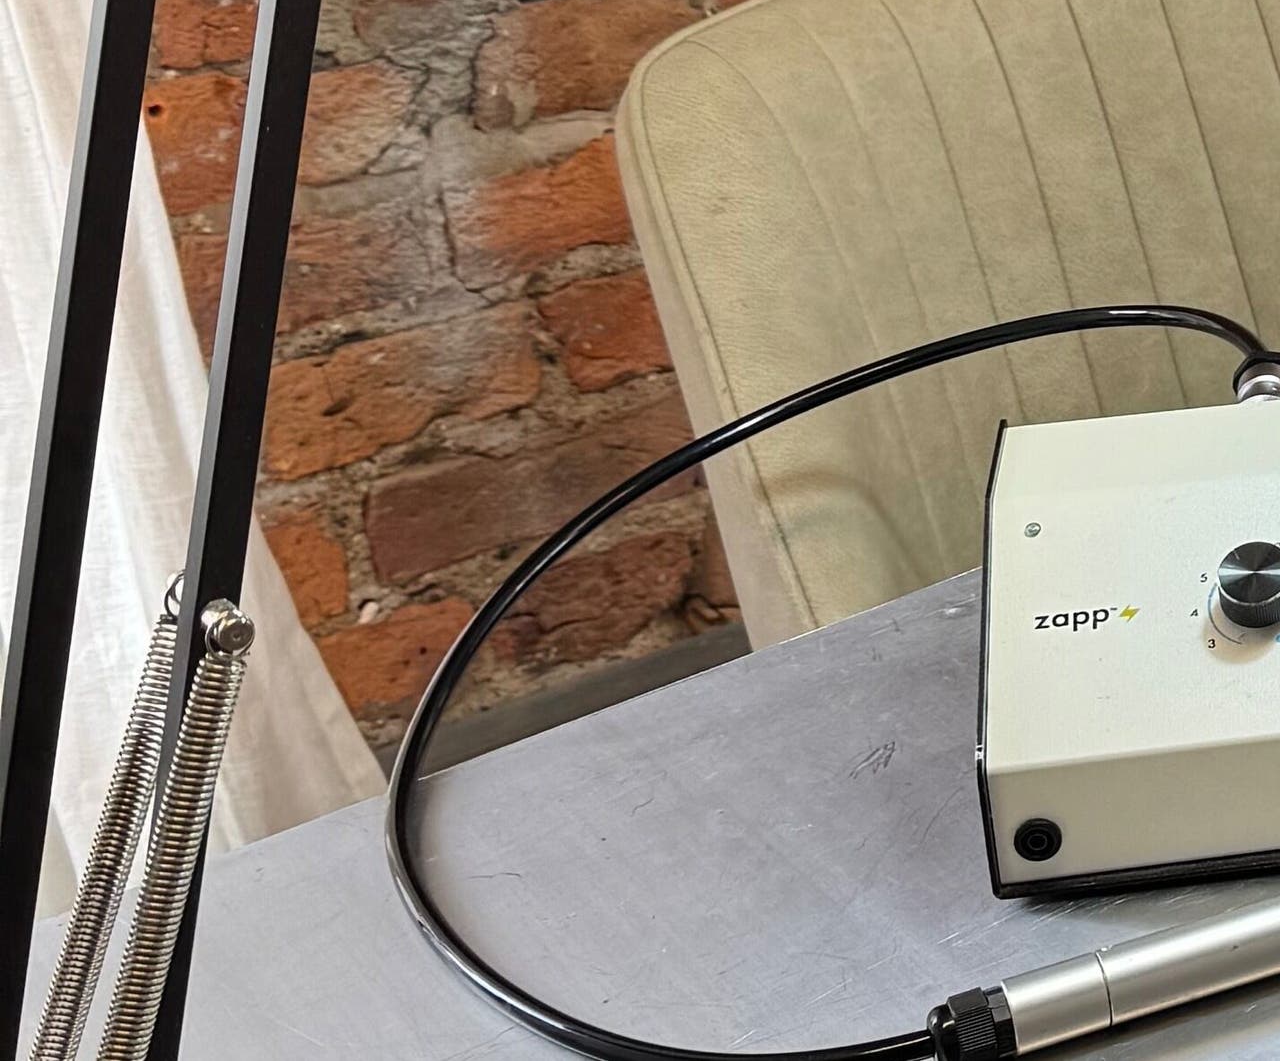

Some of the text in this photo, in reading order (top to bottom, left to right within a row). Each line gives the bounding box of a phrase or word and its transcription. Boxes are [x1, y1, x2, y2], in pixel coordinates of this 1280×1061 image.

[1200, 572, 1208, 584] 5
[1190, 608, 1199, 618] 4
[1207, 638, 1217, 650] 3
